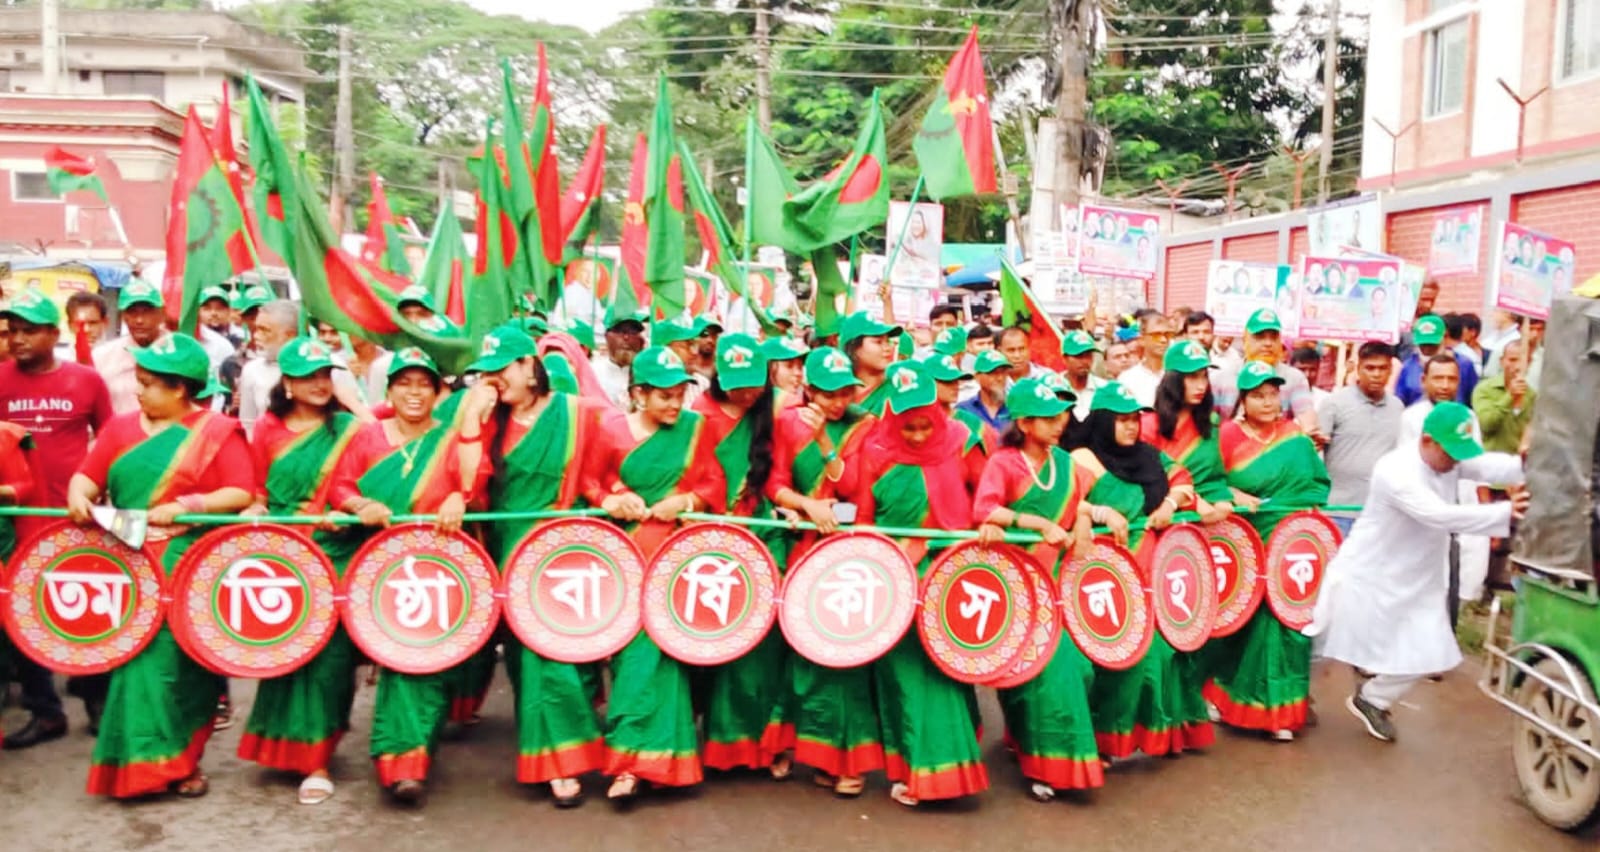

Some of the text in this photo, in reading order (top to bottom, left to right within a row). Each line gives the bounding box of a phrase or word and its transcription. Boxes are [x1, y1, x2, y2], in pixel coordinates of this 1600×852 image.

[8, 398, 73, 413] MILANO
[43, 572, 131, 627] তম
[221, 557, 301, 630] তি
[386, 555, 457, 632] ষ্ঠা
[545, 561, 608, 620] বা
[680, 556, 742, 626] র্ষি
[818, 561, 884, 627] কী
[1165, 569, 1193, 619] হ
[1284, 552, 1318, 594] ক
[960, 581, 1000, 638] স
[1082, 581, 1119, 626] ল
